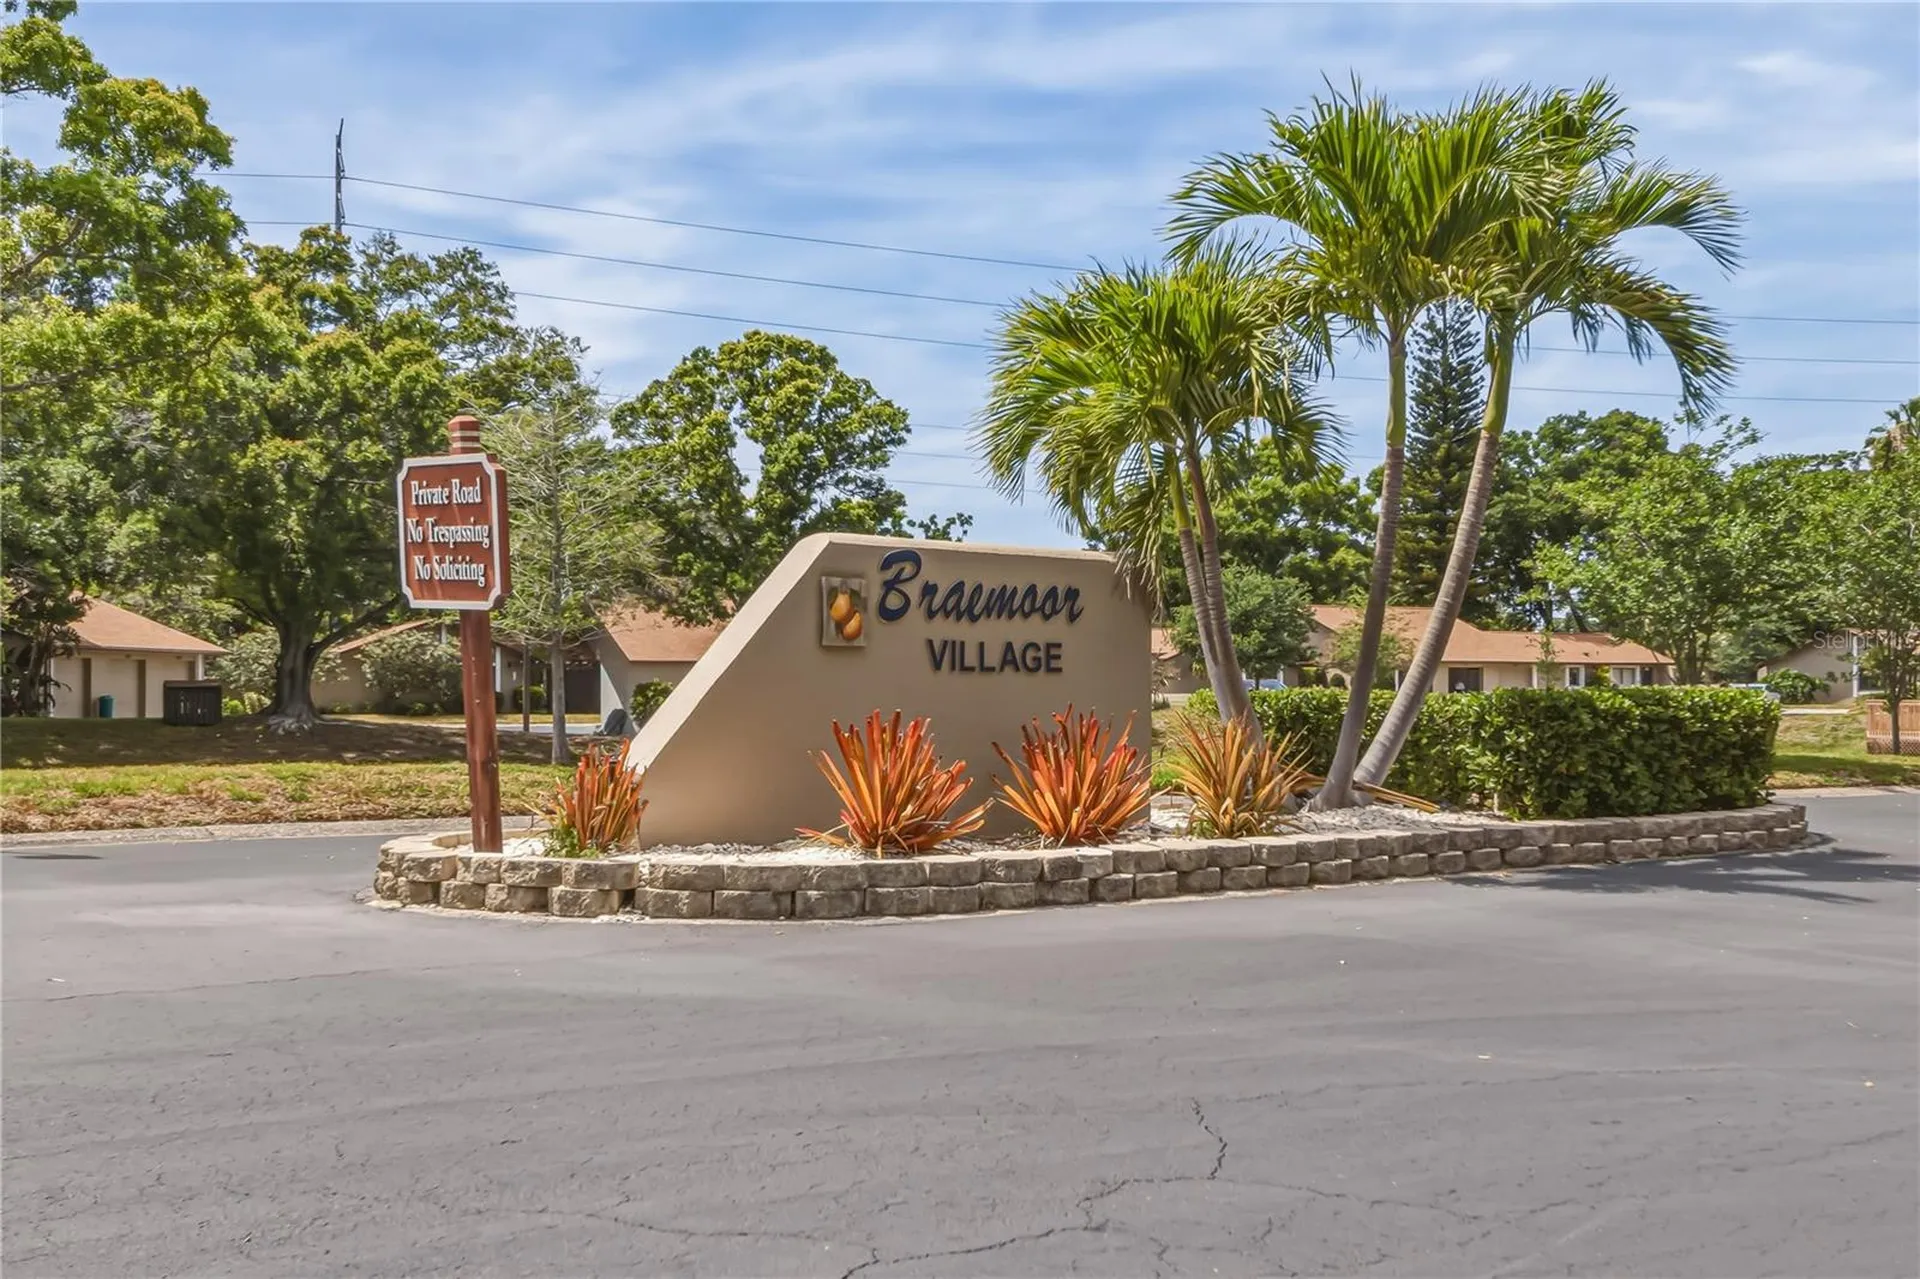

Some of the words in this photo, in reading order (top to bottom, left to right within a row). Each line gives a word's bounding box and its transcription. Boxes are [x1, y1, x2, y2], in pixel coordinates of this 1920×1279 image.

[410, 480, 449, 505] Private
[451, 477, 481, 504] Road
[406, 518, 423, 543] No
[425, 517, 490, 548] Trespassing
[413, 555, 431, 580] No
[432, 555, 485, 587] Soliciting
[878, 550, 1084, 624] Braemoor
[927, 638, 1063, 673] VILLAGE
